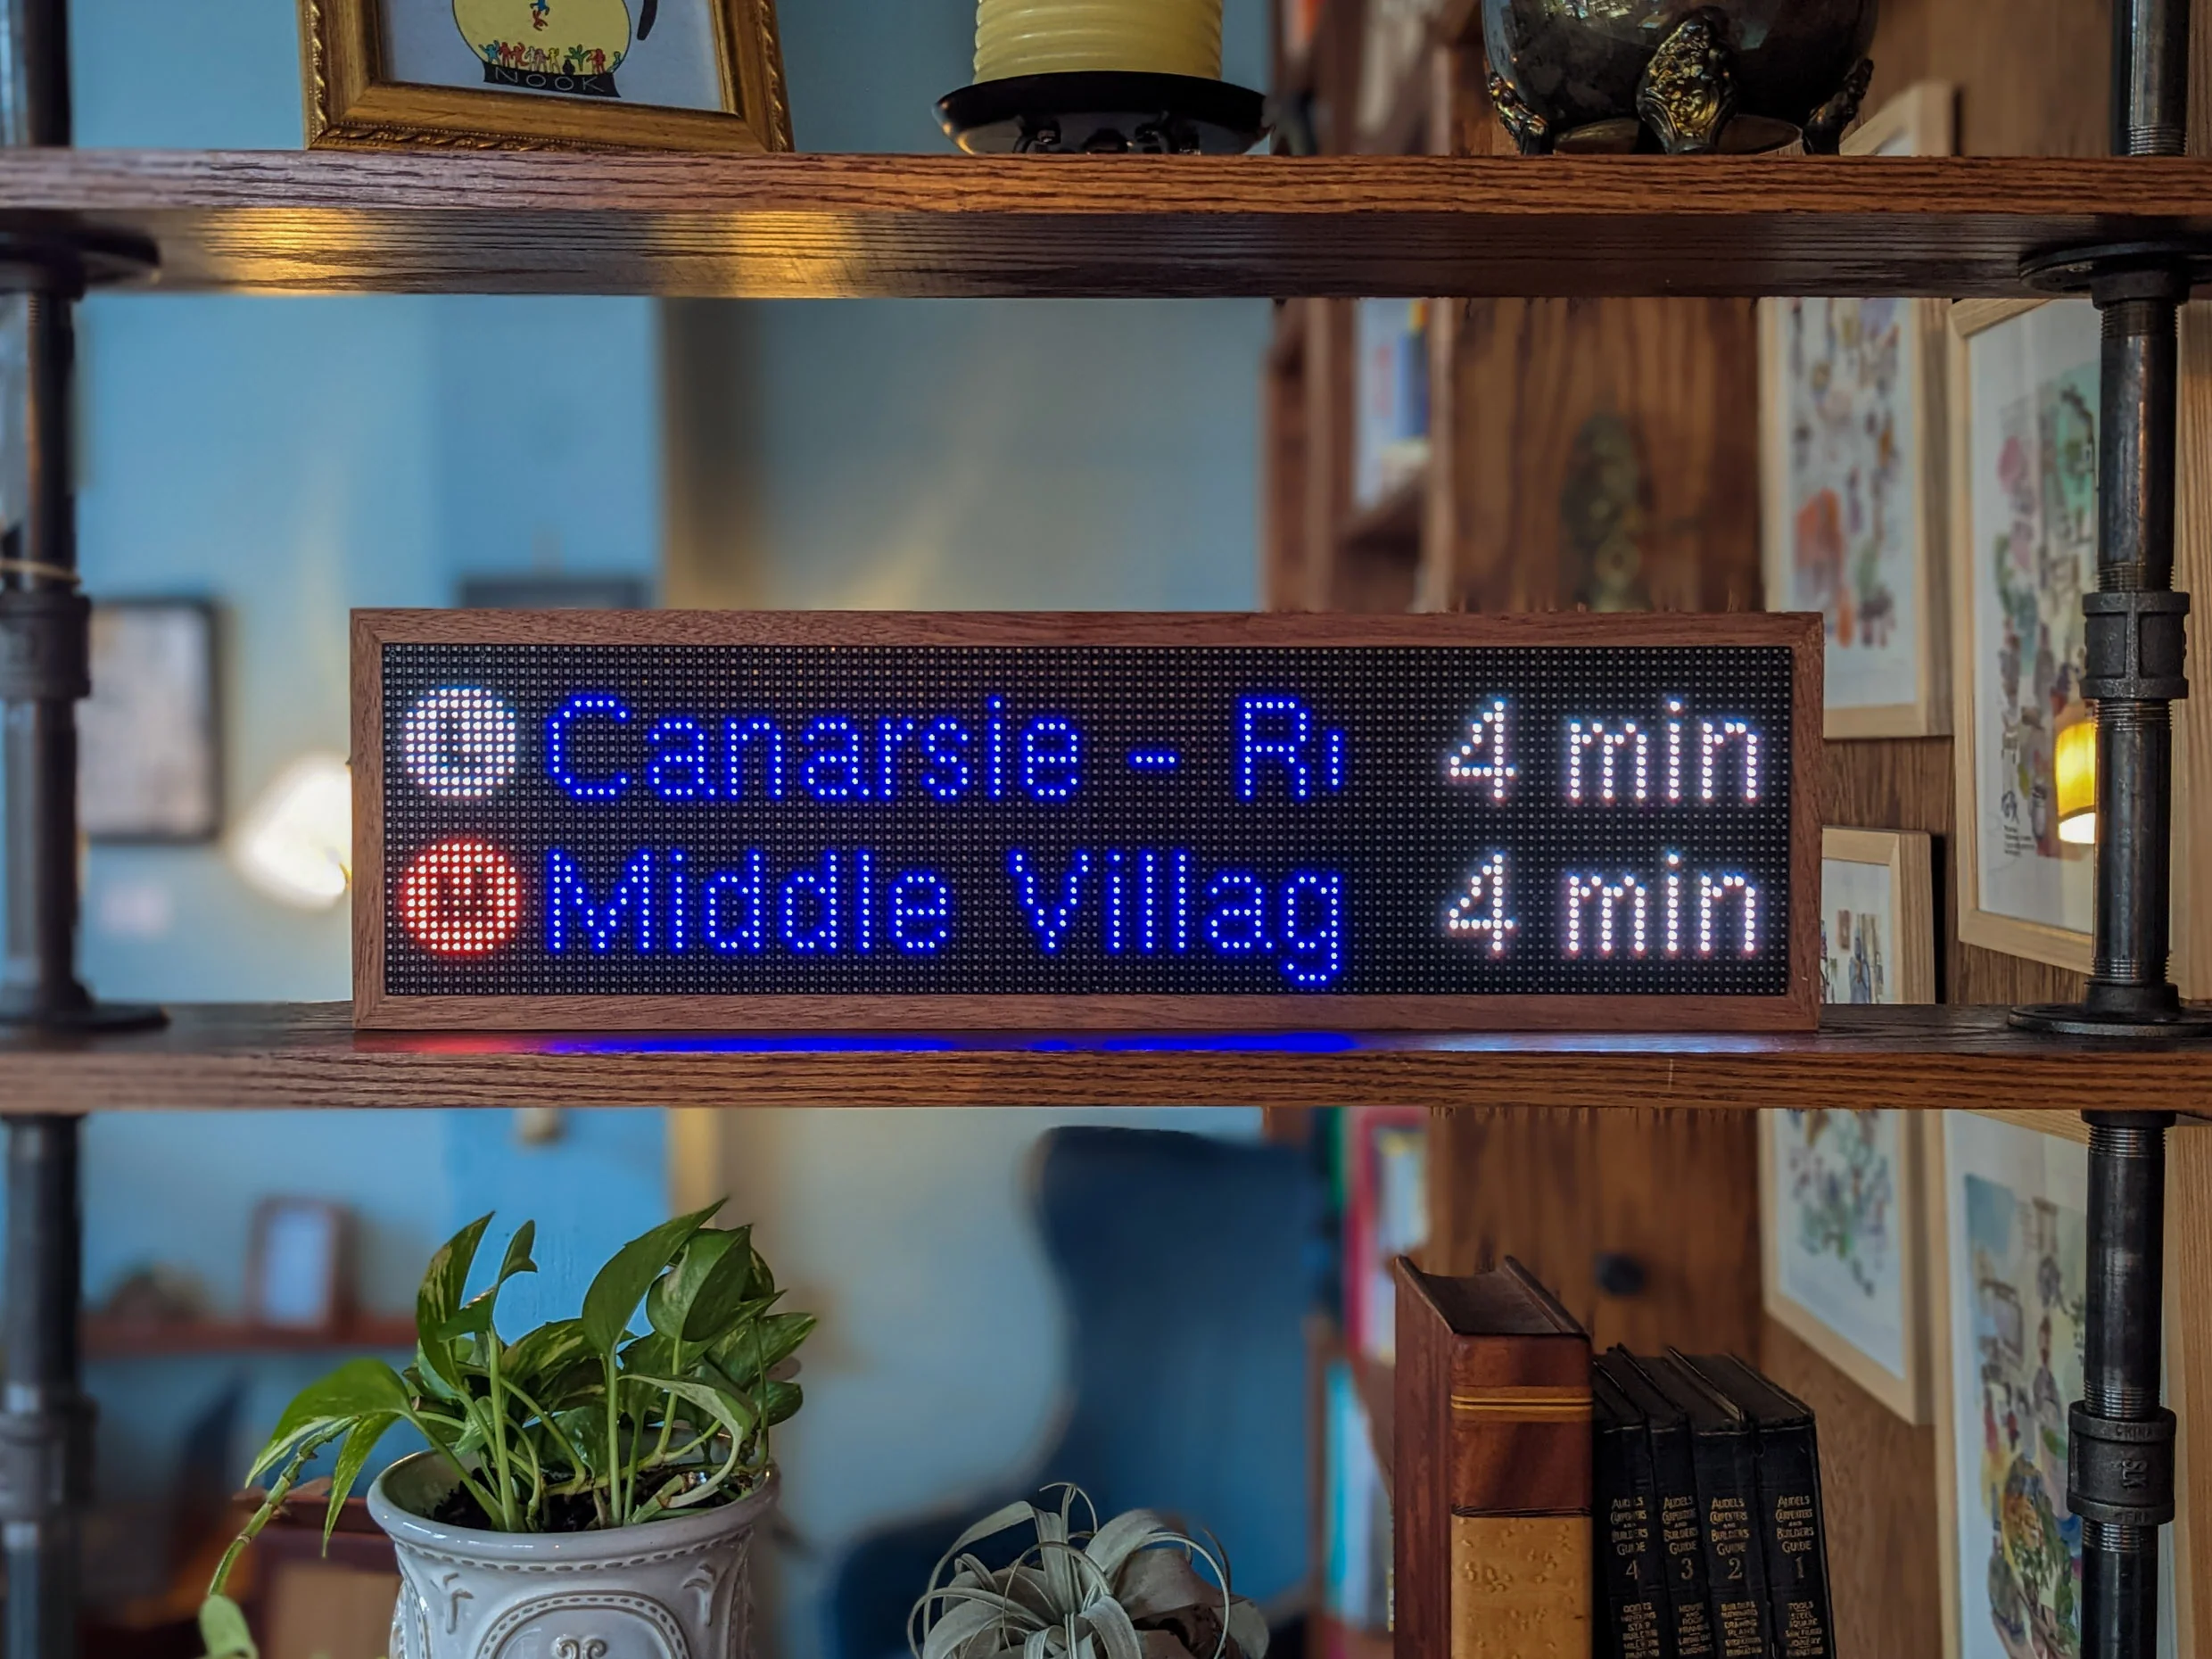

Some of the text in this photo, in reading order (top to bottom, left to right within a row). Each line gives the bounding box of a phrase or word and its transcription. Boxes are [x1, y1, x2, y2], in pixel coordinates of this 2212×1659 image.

[495, 67, 606, 93] NOOK
[546, 695, 1077, 796] Canarsie
[1449, 699, 1515, 799] 4
[1569, 699, 1758, 799] min
[547, 848, 948, 952] Middle
[1008, 850, 1341, 983] Villag
[1449, 853, 1514, 953] 4
[1567, 853, 1757, 953] min
[1663, 1495, 1694, 1510] AUDELS
[1712, 1497, 1746, 1510] AUDELS
[1777, 1495, 1811, 1508] AUDELS
[1776, 1526, 1814, 1540] BUILDERS
[1616, 1541, 1646, 1556] GUIDE
[1669, 1540, 1697, 1556] GUIDE
[1716, 1541, 1746, 1556] GUIDE
[1781, 1539, 1812, 1555] GUIDE
[1625, 1559, 1639, 1581] 4
[1680, 1557, 1695, 1581] 3
[1727, 1556, 1743, 1580] 2
[1795, 1555, 1805, 1580] 1
